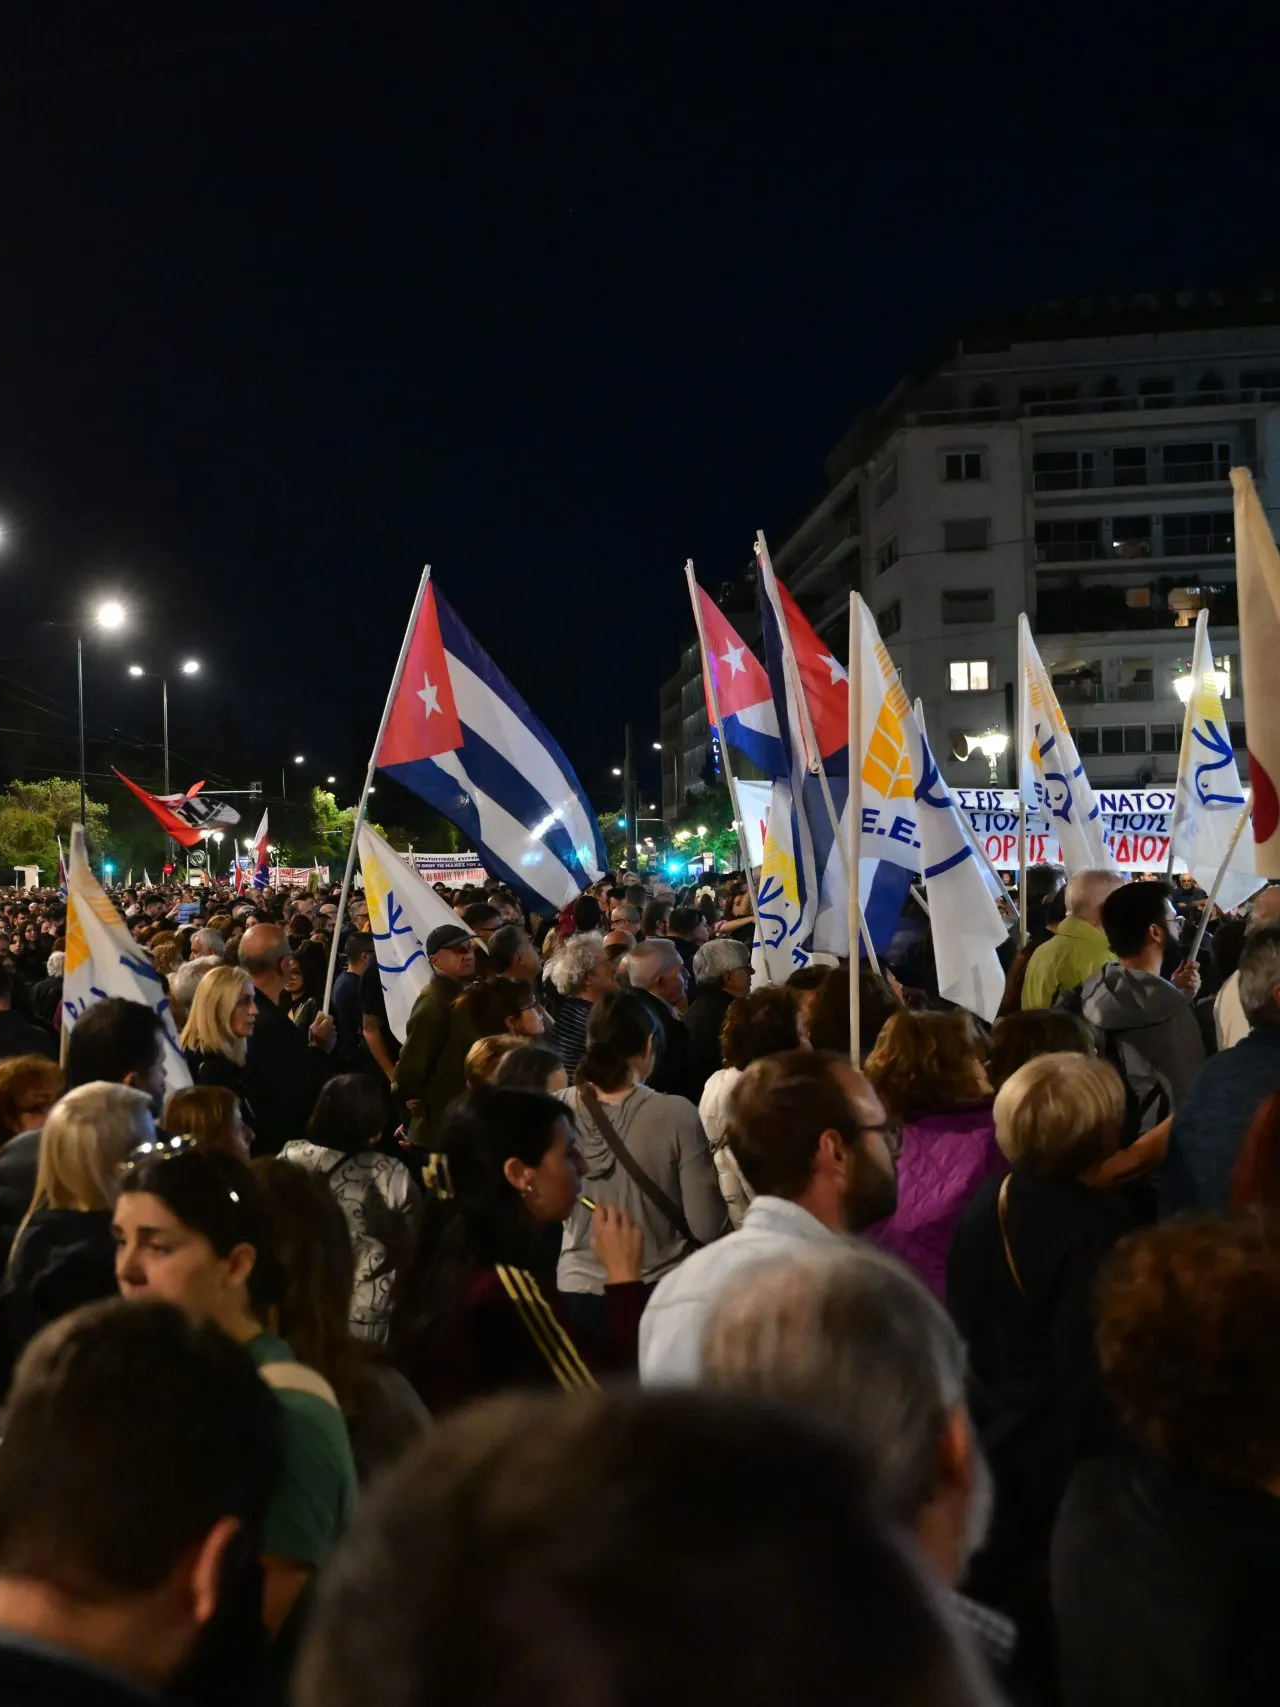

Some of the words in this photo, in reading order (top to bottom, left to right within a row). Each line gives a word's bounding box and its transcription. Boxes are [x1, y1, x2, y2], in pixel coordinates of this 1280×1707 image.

[957, 791, 1005, 811] ΣΕΙΣ
[1100, 792, 1176, 812] ΝΑΤΟΥ
[1111, 814, 1167, 833] ΜΟΥΣ
[1110, 834, 1171, 862] ΔΙΟΥ
